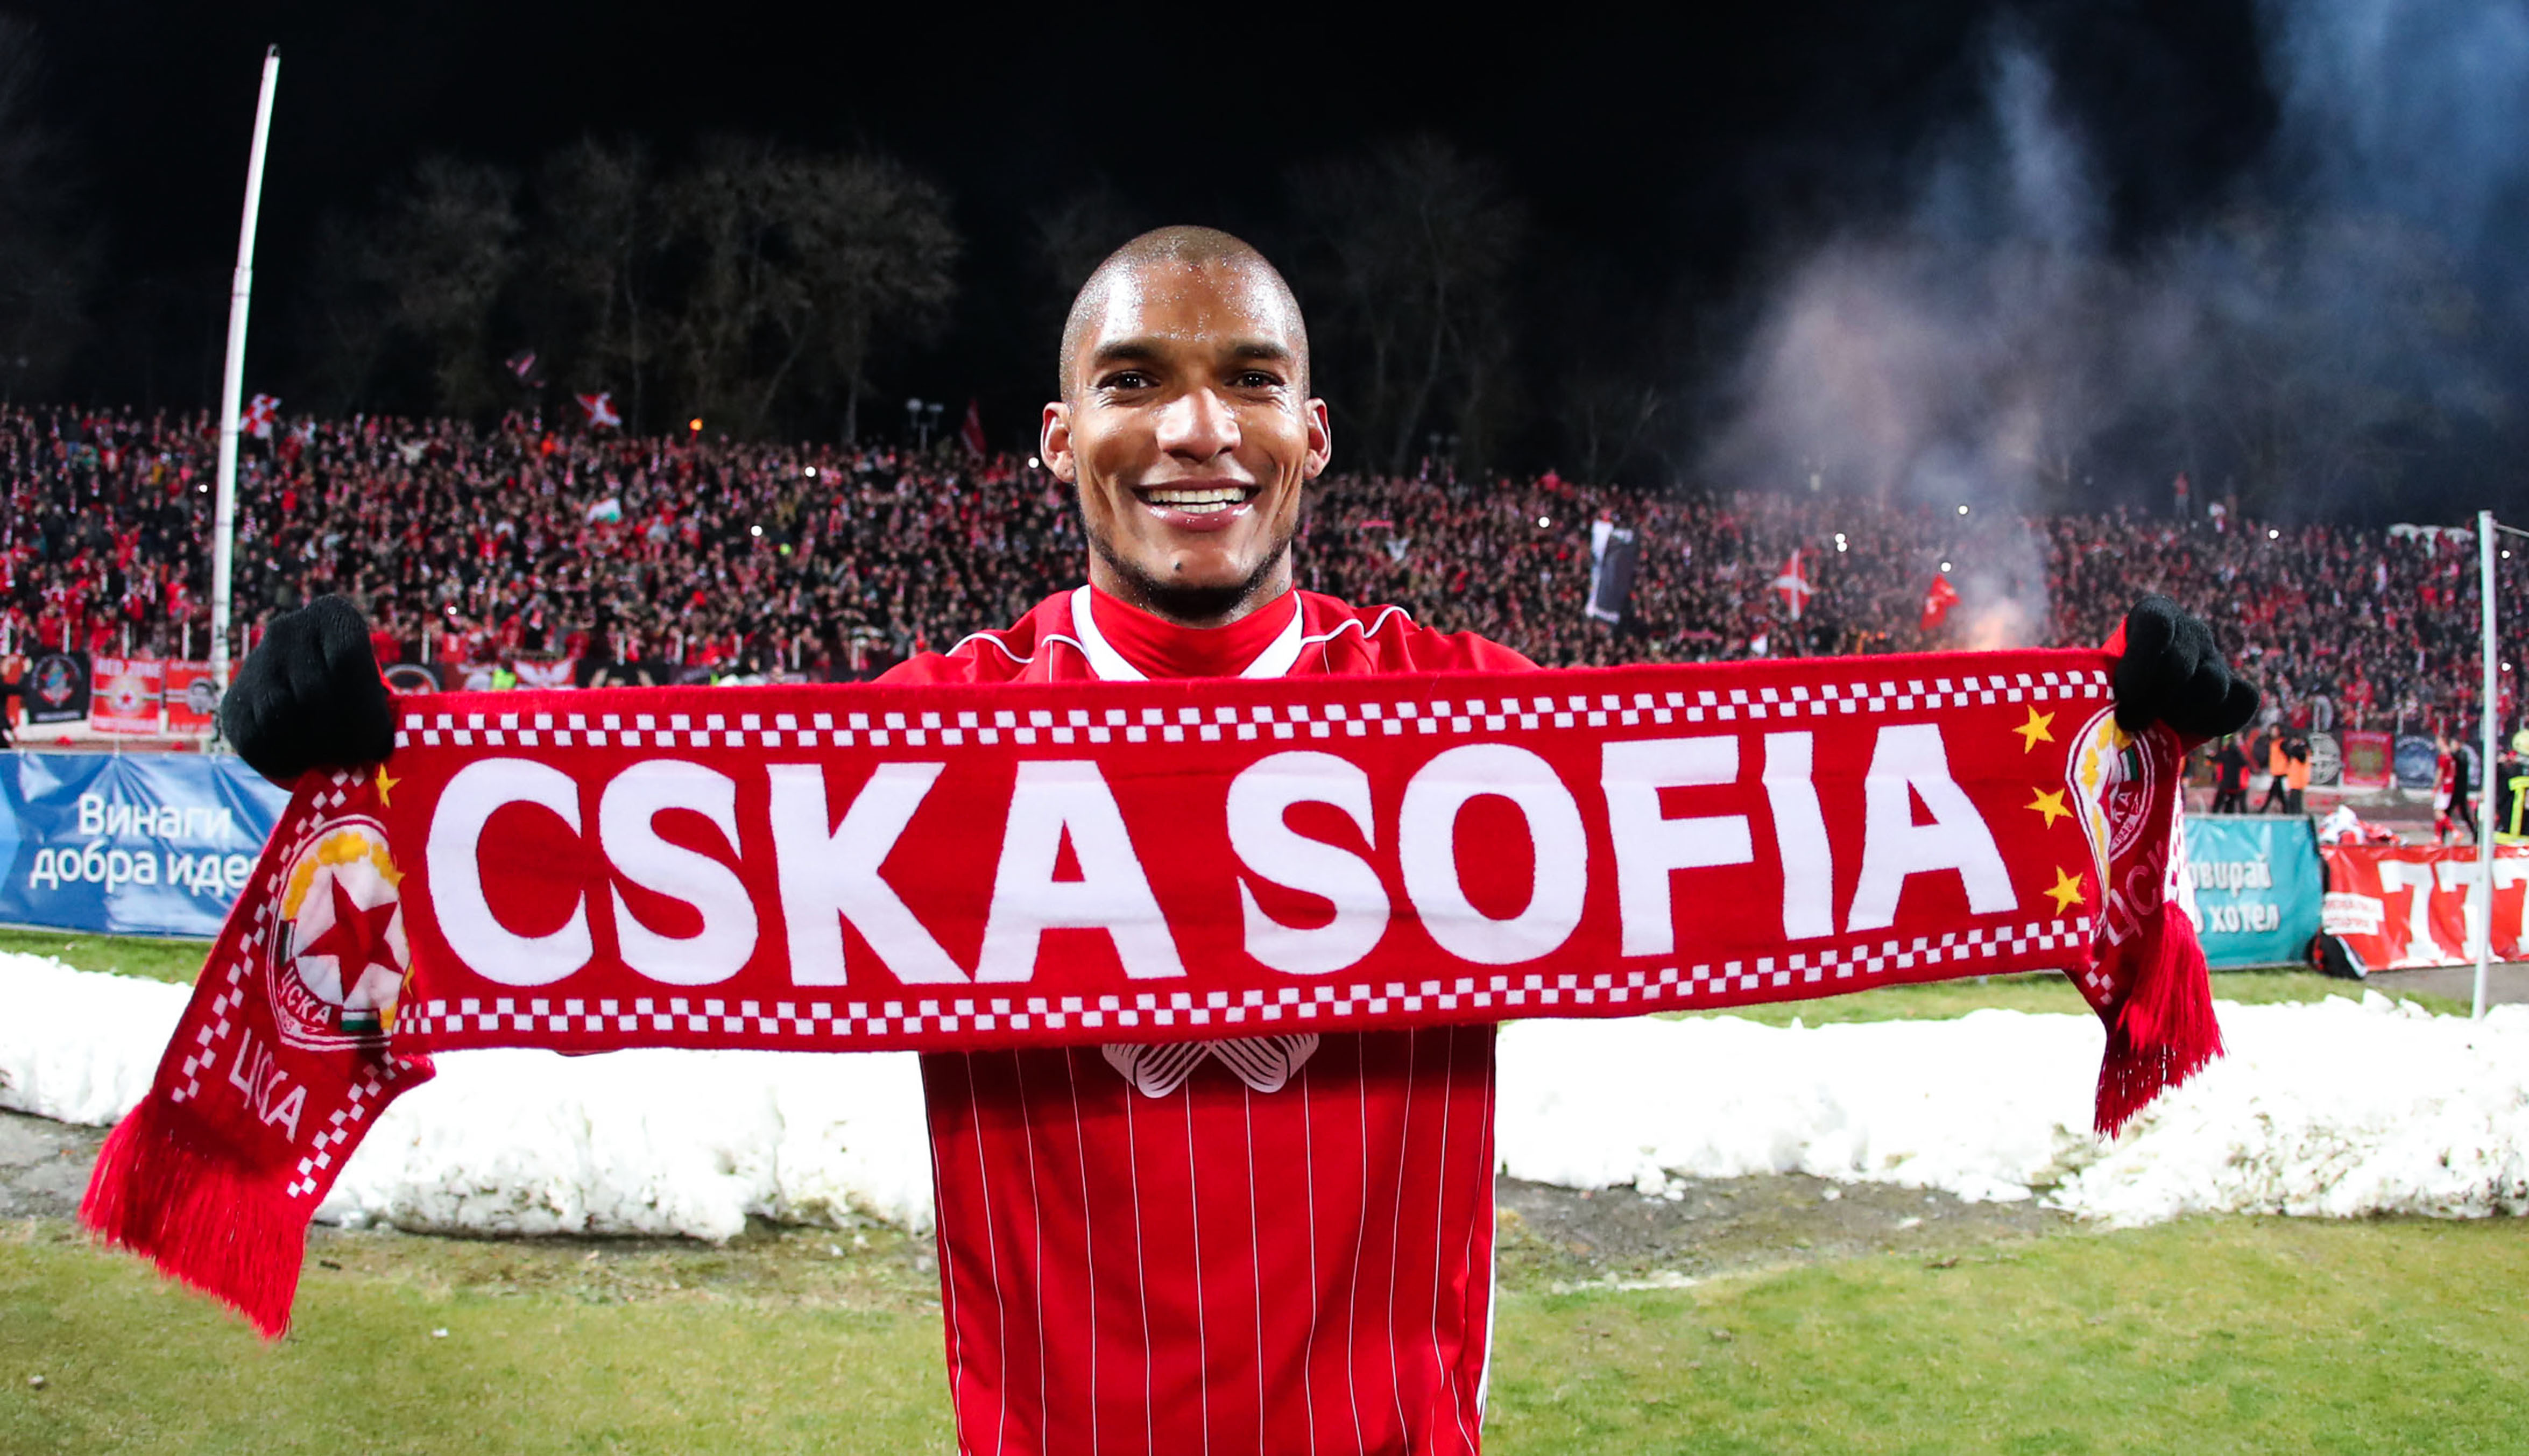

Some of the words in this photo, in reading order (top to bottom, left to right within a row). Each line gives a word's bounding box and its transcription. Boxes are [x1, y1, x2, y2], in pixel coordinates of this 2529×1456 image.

[78, 792, 232, 839] Винаги
[29, 839, 158, 894] добра
[427, 758, 1186, 986] CSKA
[1226, 723, 2018, 974] SOFIA
[2208, 902, 2280, 933] хотел
[280, 966, 332, 1024] ЦСКА
[229, 1027, 308, 1144] ЦСКА
